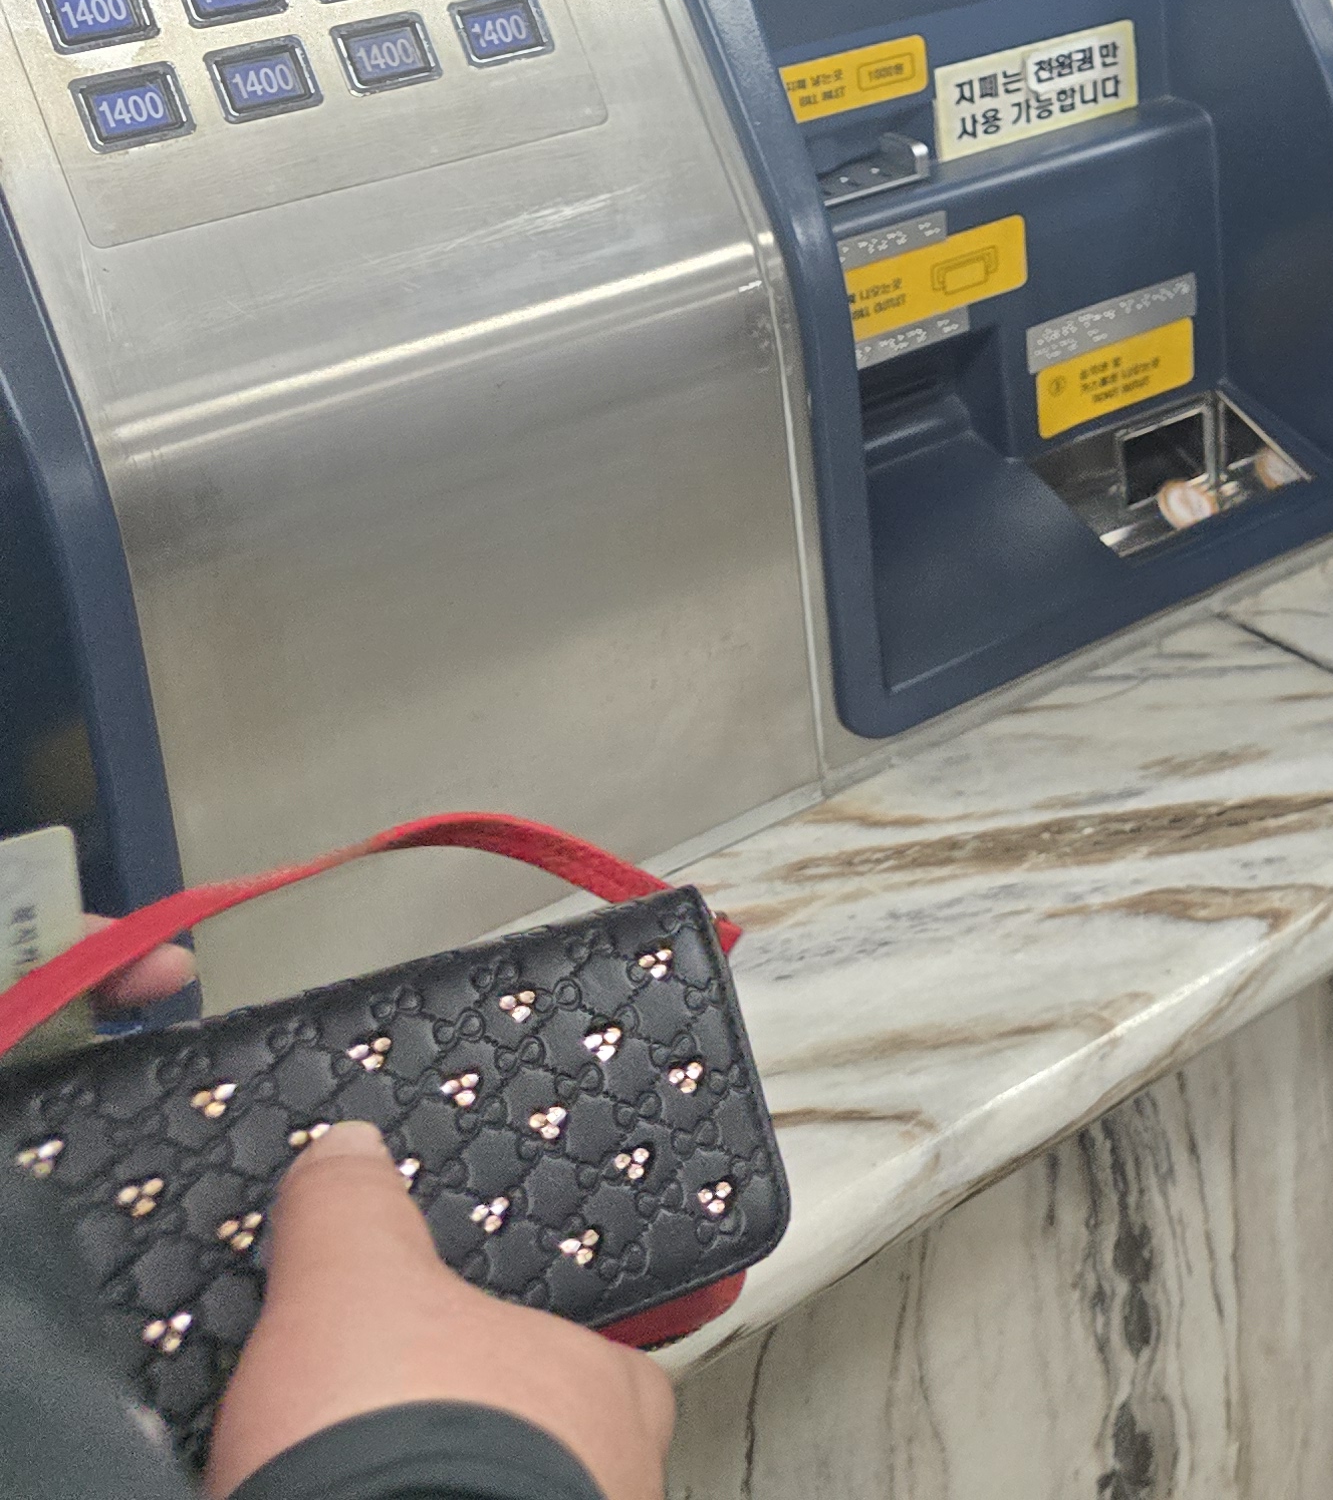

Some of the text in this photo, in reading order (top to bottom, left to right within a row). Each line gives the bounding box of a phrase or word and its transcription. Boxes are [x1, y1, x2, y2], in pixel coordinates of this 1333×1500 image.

[471, 15, 527, 46] 1400
[356, 39, 414, 72] 1400
[232, 65, 294, 99] 1400
[954, 67, 1024, 108] 지폐는
[98, 91, 166, 129] 1400
[956, 73, 1121, 142] 사용 가능합니다
